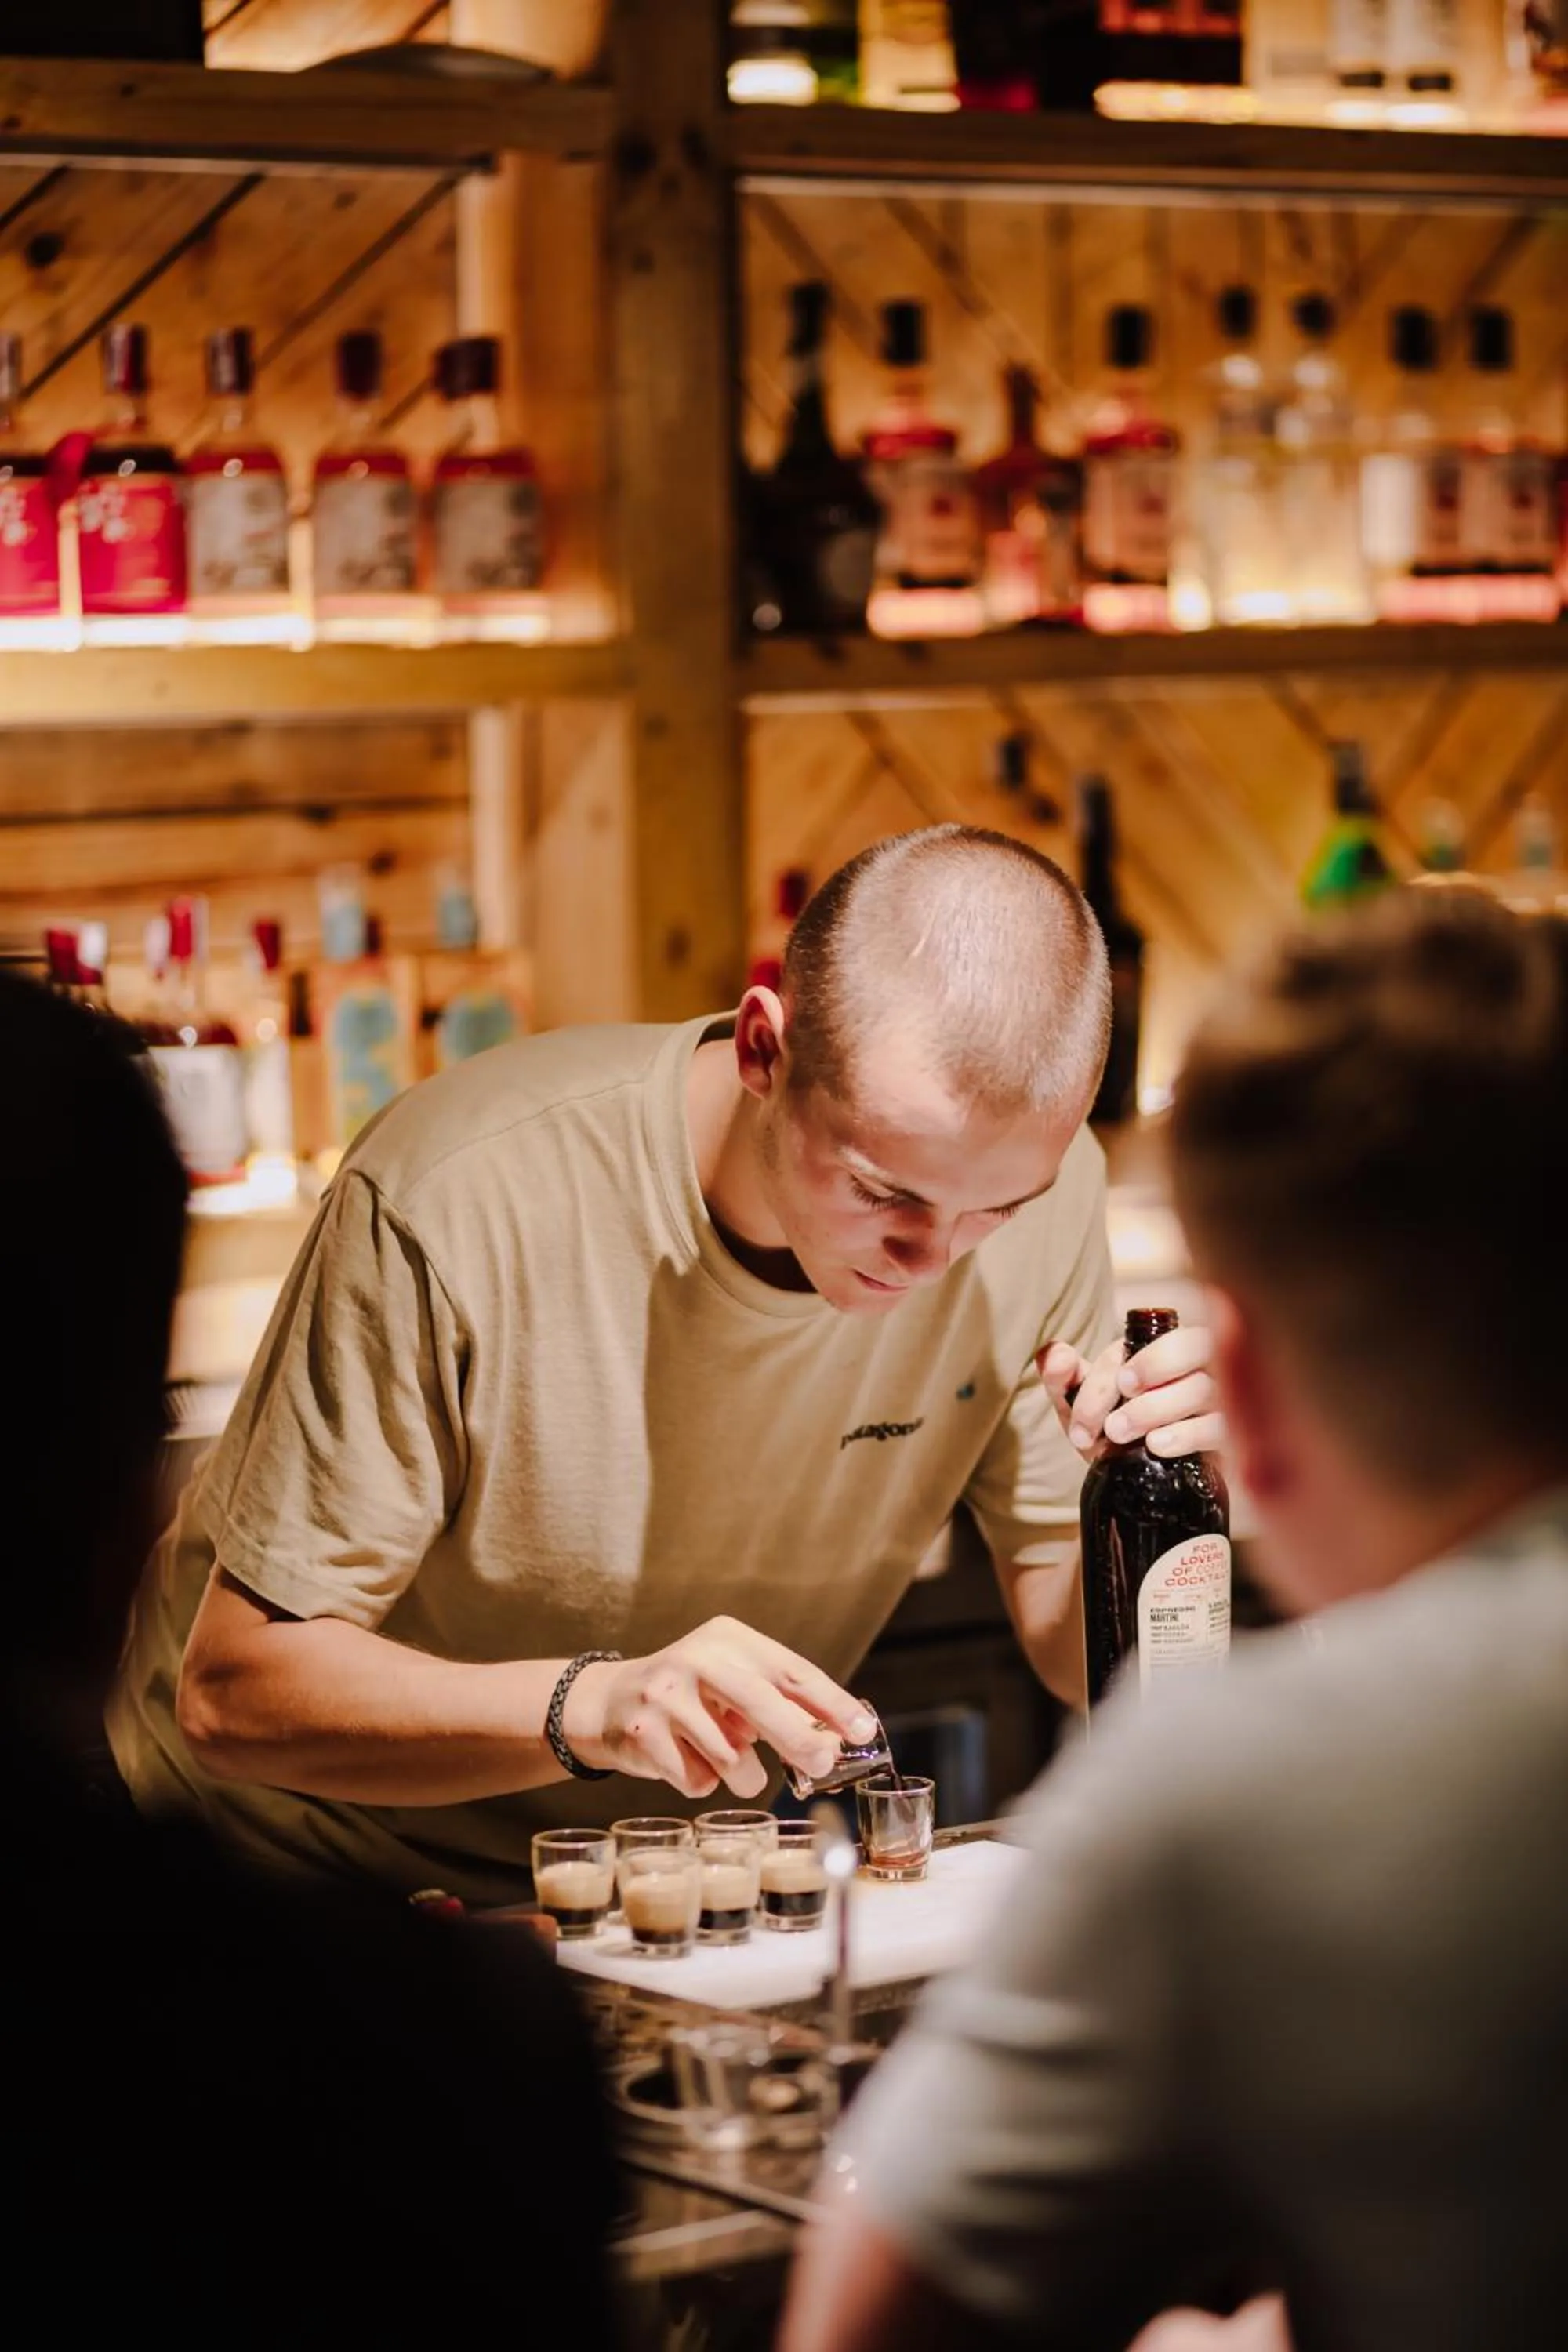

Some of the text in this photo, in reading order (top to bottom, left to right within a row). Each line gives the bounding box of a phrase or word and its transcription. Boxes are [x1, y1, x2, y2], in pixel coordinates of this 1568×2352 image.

[1192, 1543, 1218, 1553] FOR
[1180, 1552, 1225, 1566] LOVERS
[1172, 1566, 1192, 1576] OF
